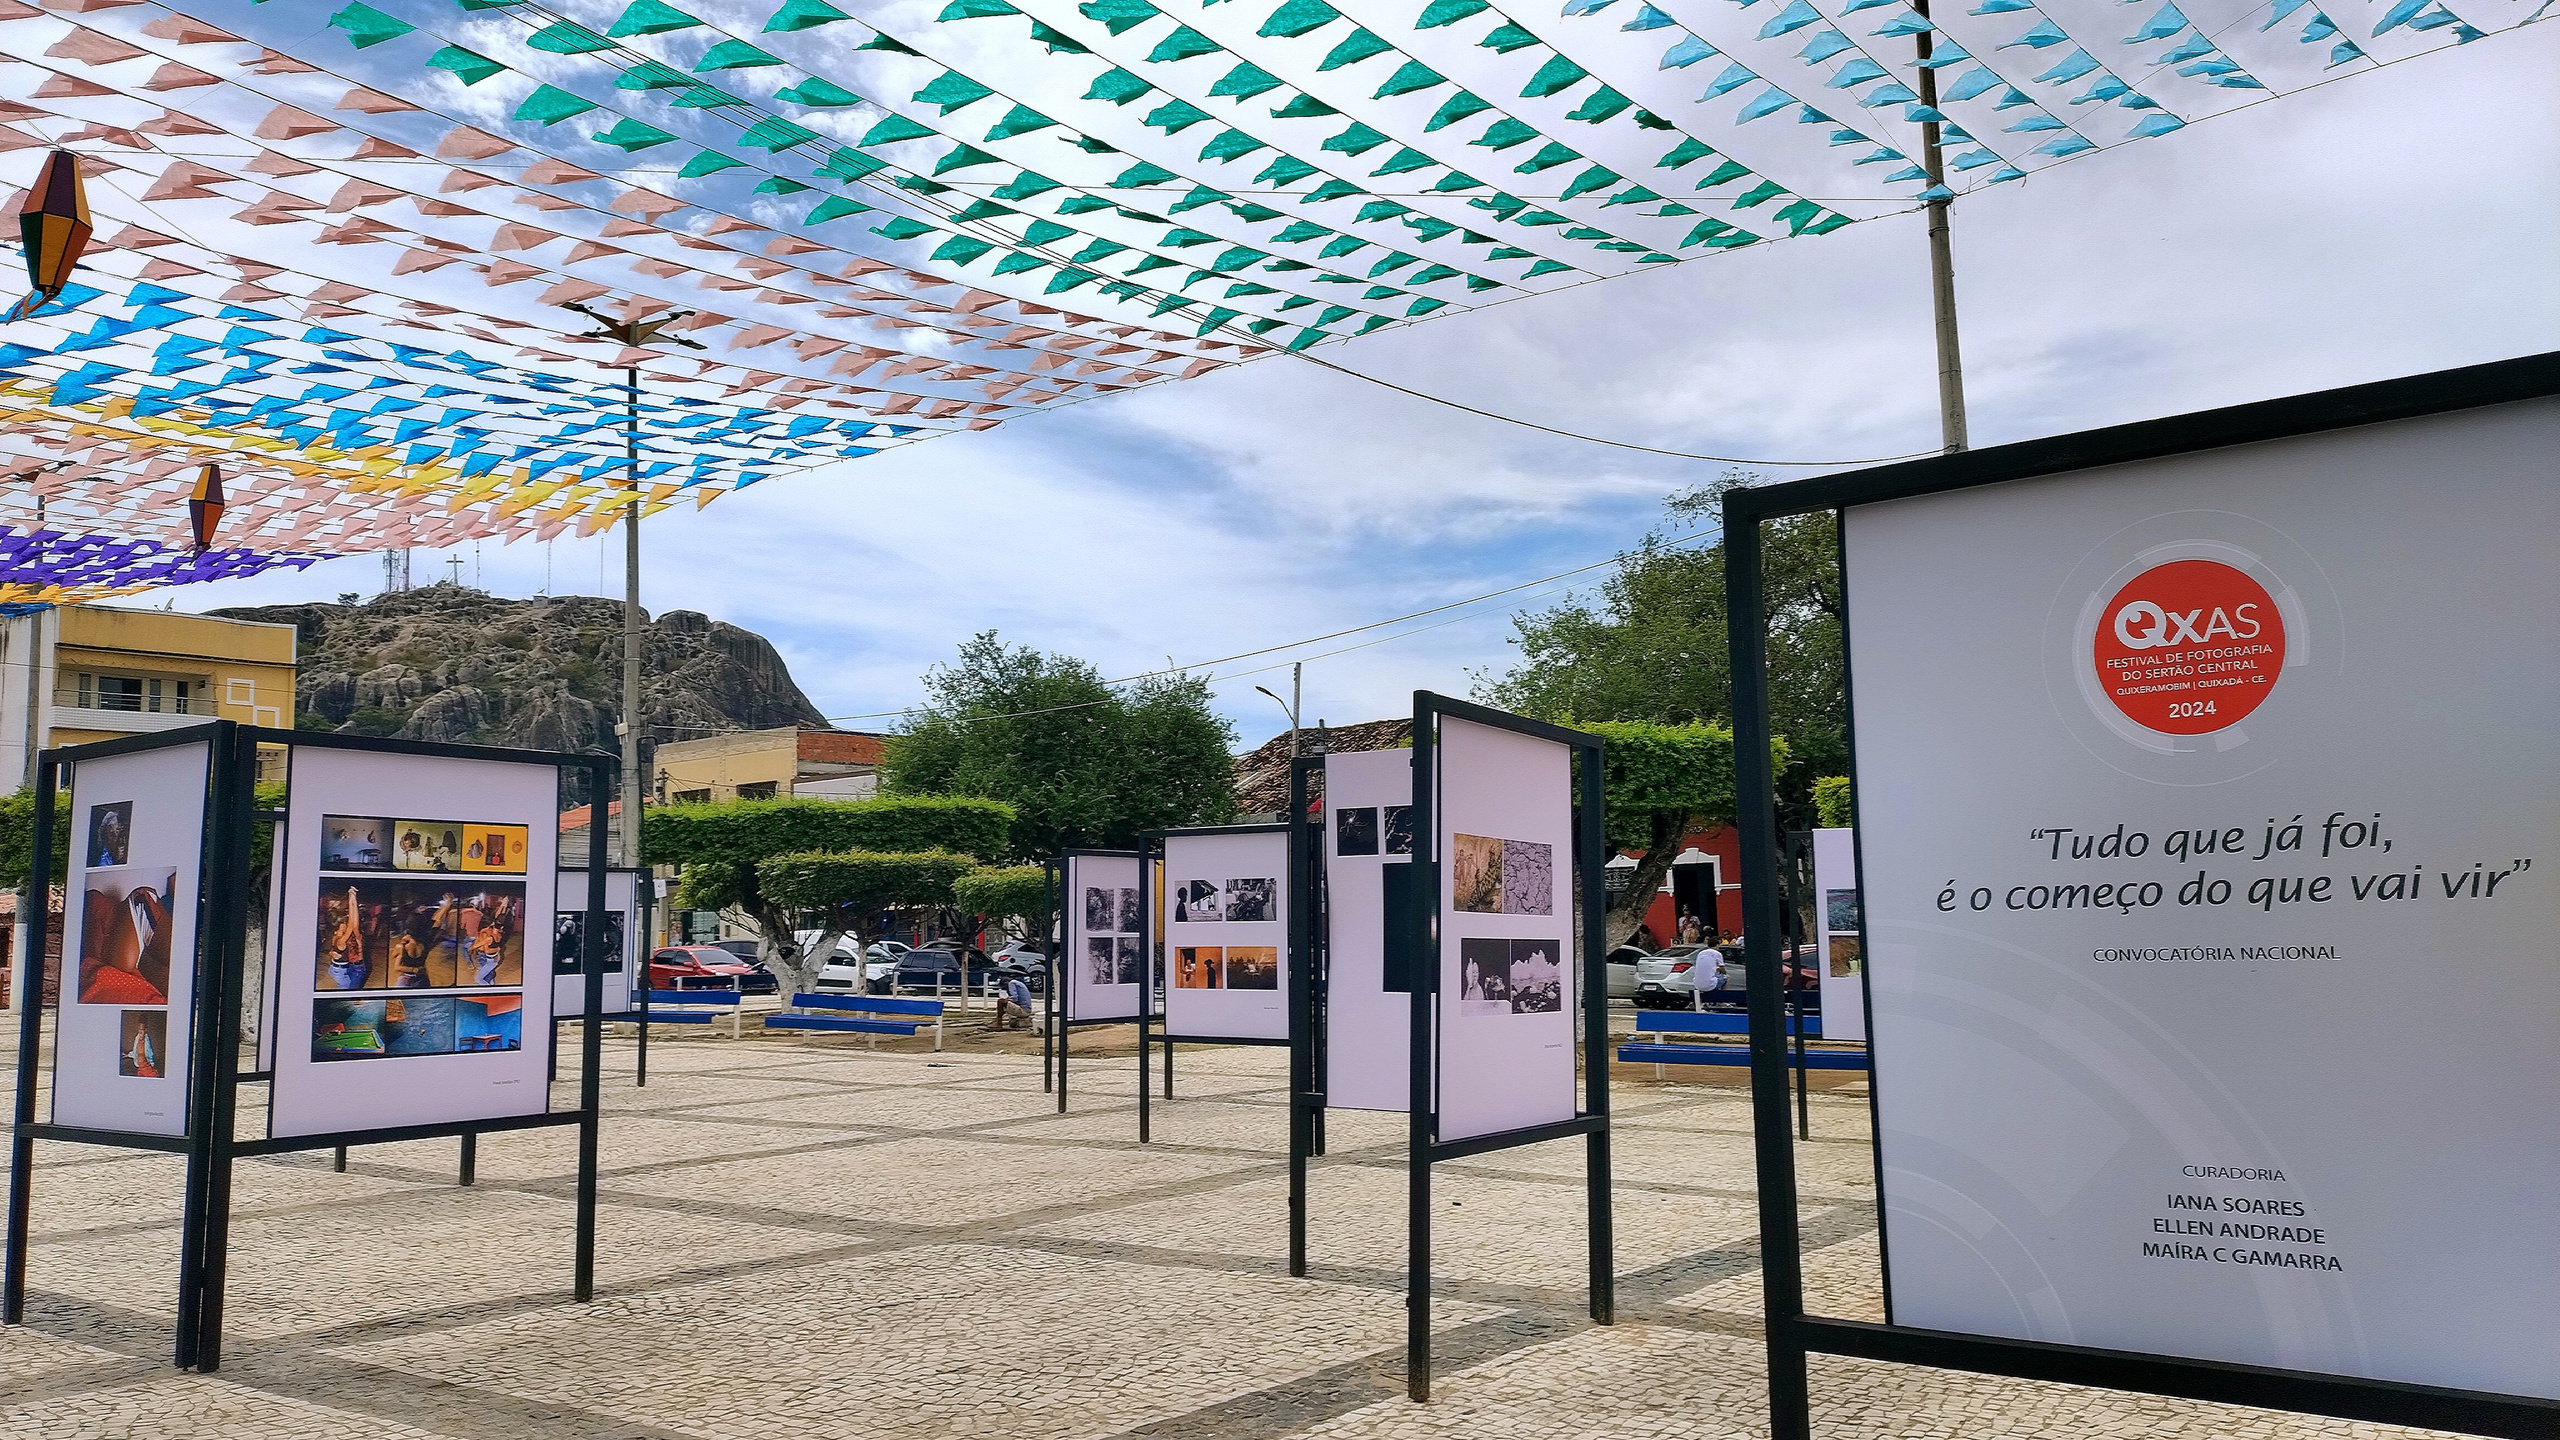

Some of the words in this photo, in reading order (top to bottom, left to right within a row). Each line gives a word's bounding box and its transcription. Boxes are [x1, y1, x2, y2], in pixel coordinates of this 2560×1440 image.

[2106, 654, 2163, 669] FESTIVAL
[2165, 652, 2184, 664] DE
[2187, 644, 2273, 661] FOTOGRAFIA
[2122, 669, 2142, 681] DO
[2145, 664, 2194, 679] SERTÃO
[2197, 659, 2258, 674] CENTRAL
[2116, 682, 2191, 695] QUIXERAMOBIM
[2198, 675, 2244, 689] QUIXADÁ
[2251, 674, 2268, 684] CE.
[2168, 700, 2217, 719] 2024
[2029, 824, 2150, 861] “Tudo
[2163, 826, 2246, 863] que
[2252, 814, 2303, 861] já
[2321, 812, 2394, 858] foi,
[1936, 879, 1957, 912] é
[1969, 886, 1993, 911] o
[2005, 881, 2164, 915] começo
[2178, 870, 2232, 906] do
[2246, 874, 2333, 912] que
[2350, 864, 2422, 902] vai
[2441, 858, 2533, 899] vir”
[2093, 945, 2236, 962] CONVOCATÓRIA
[2240, 945, 2342, 962] NACIONAL
[2182, 1165, 2286, 1182] CURADORIA
[2167, 1194, 2218, 1212] IANA
[2222, 1197, 2305, 1217] SOARES
[2153, 1218, 2213, 1237] ELLEN
[2219, 1222, 2326, 1244] ANDRADE
[2143, 1241, 2209, 1262] MAÍRA
[2212, 1247, 2227, 1263] C
[2231, 1248, 2343, 1272] GAMARRA
